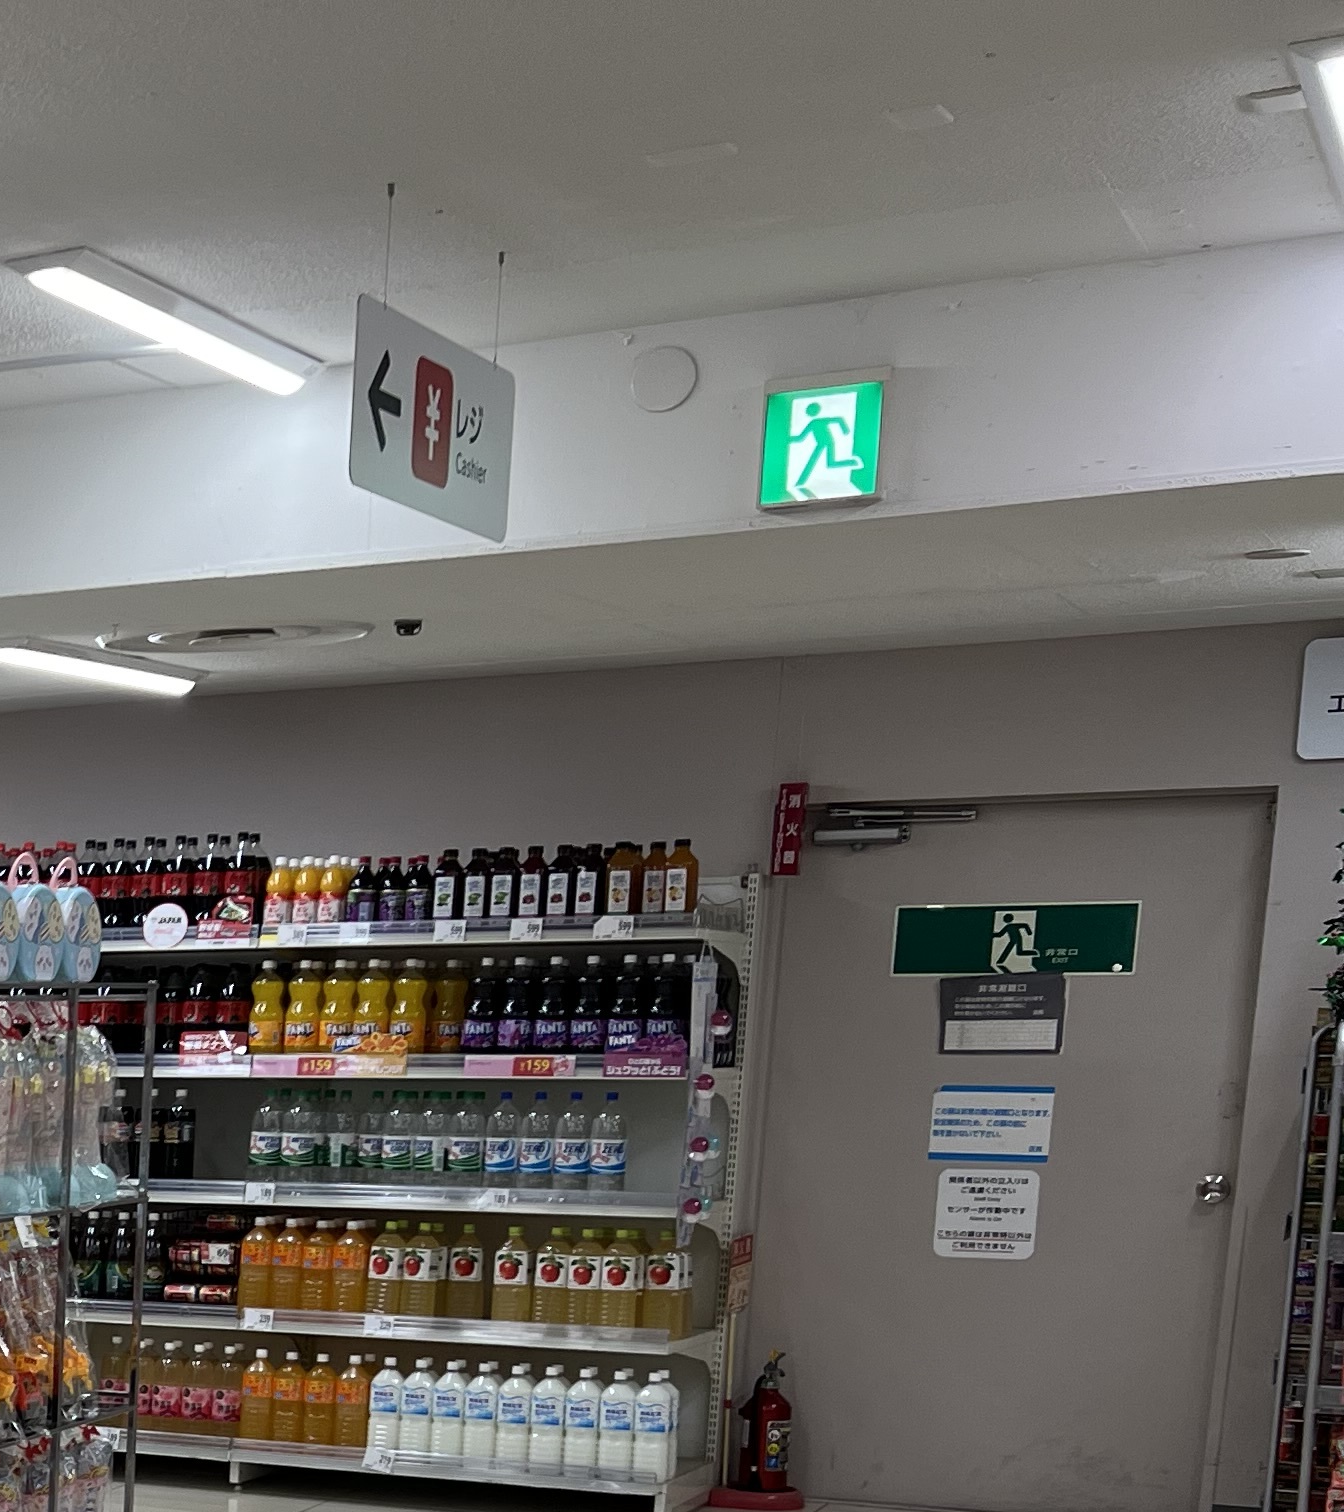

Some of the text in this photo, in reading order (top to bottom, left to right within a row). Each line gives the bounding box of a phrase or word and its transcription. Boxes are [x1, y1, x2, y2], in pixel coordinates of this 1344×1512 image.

[456, 399, 484, 444] レジ
[455, 451, 487, 484] Cashier
[1045, 948, 1079, 957] 非常口
[519, 1058, 551, 1073] ¥159
